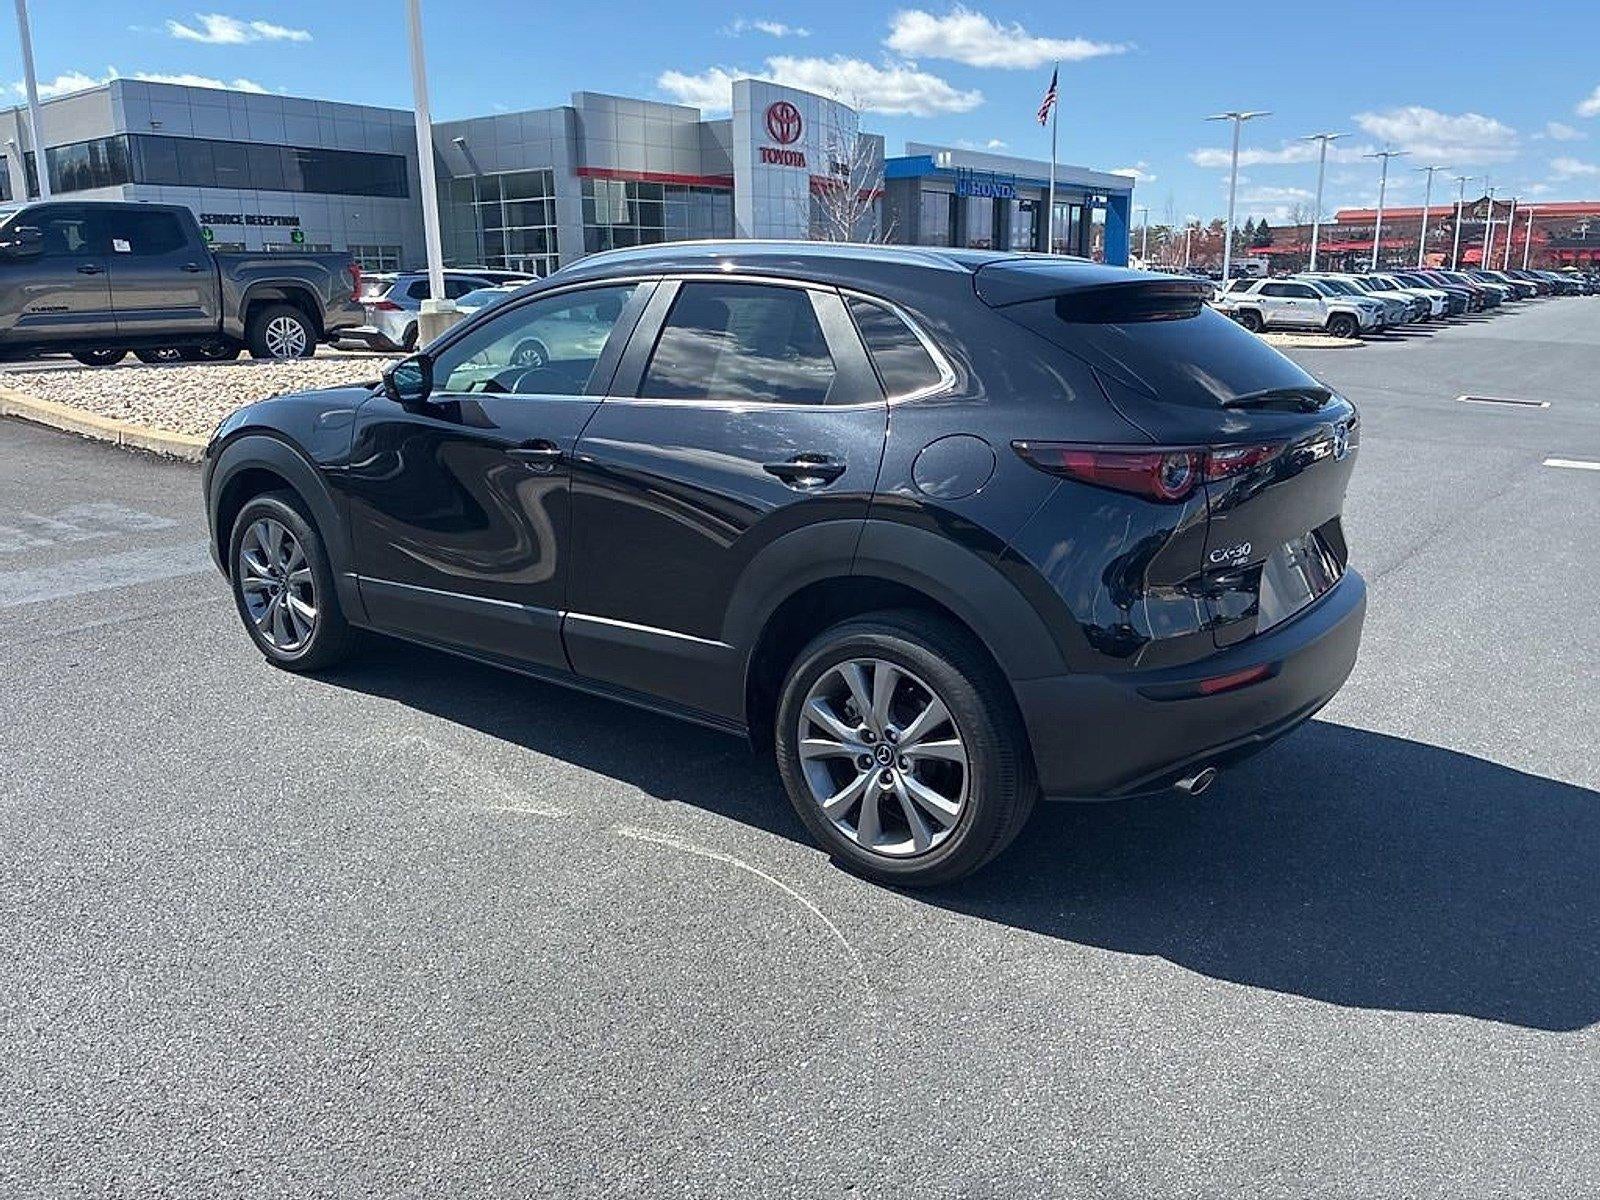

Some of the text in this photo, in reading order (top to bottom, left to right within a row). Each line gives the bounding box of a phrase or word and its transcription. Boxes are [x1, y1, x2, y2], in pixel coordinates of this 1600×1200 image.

[759, 146, 806, 168] TOYOTA
[971, 181, 1018, 199] HONDA
[200, 213, 300, 226] SERVICE RECEPTION
[1210, 542, 1252, 563] CX-30
